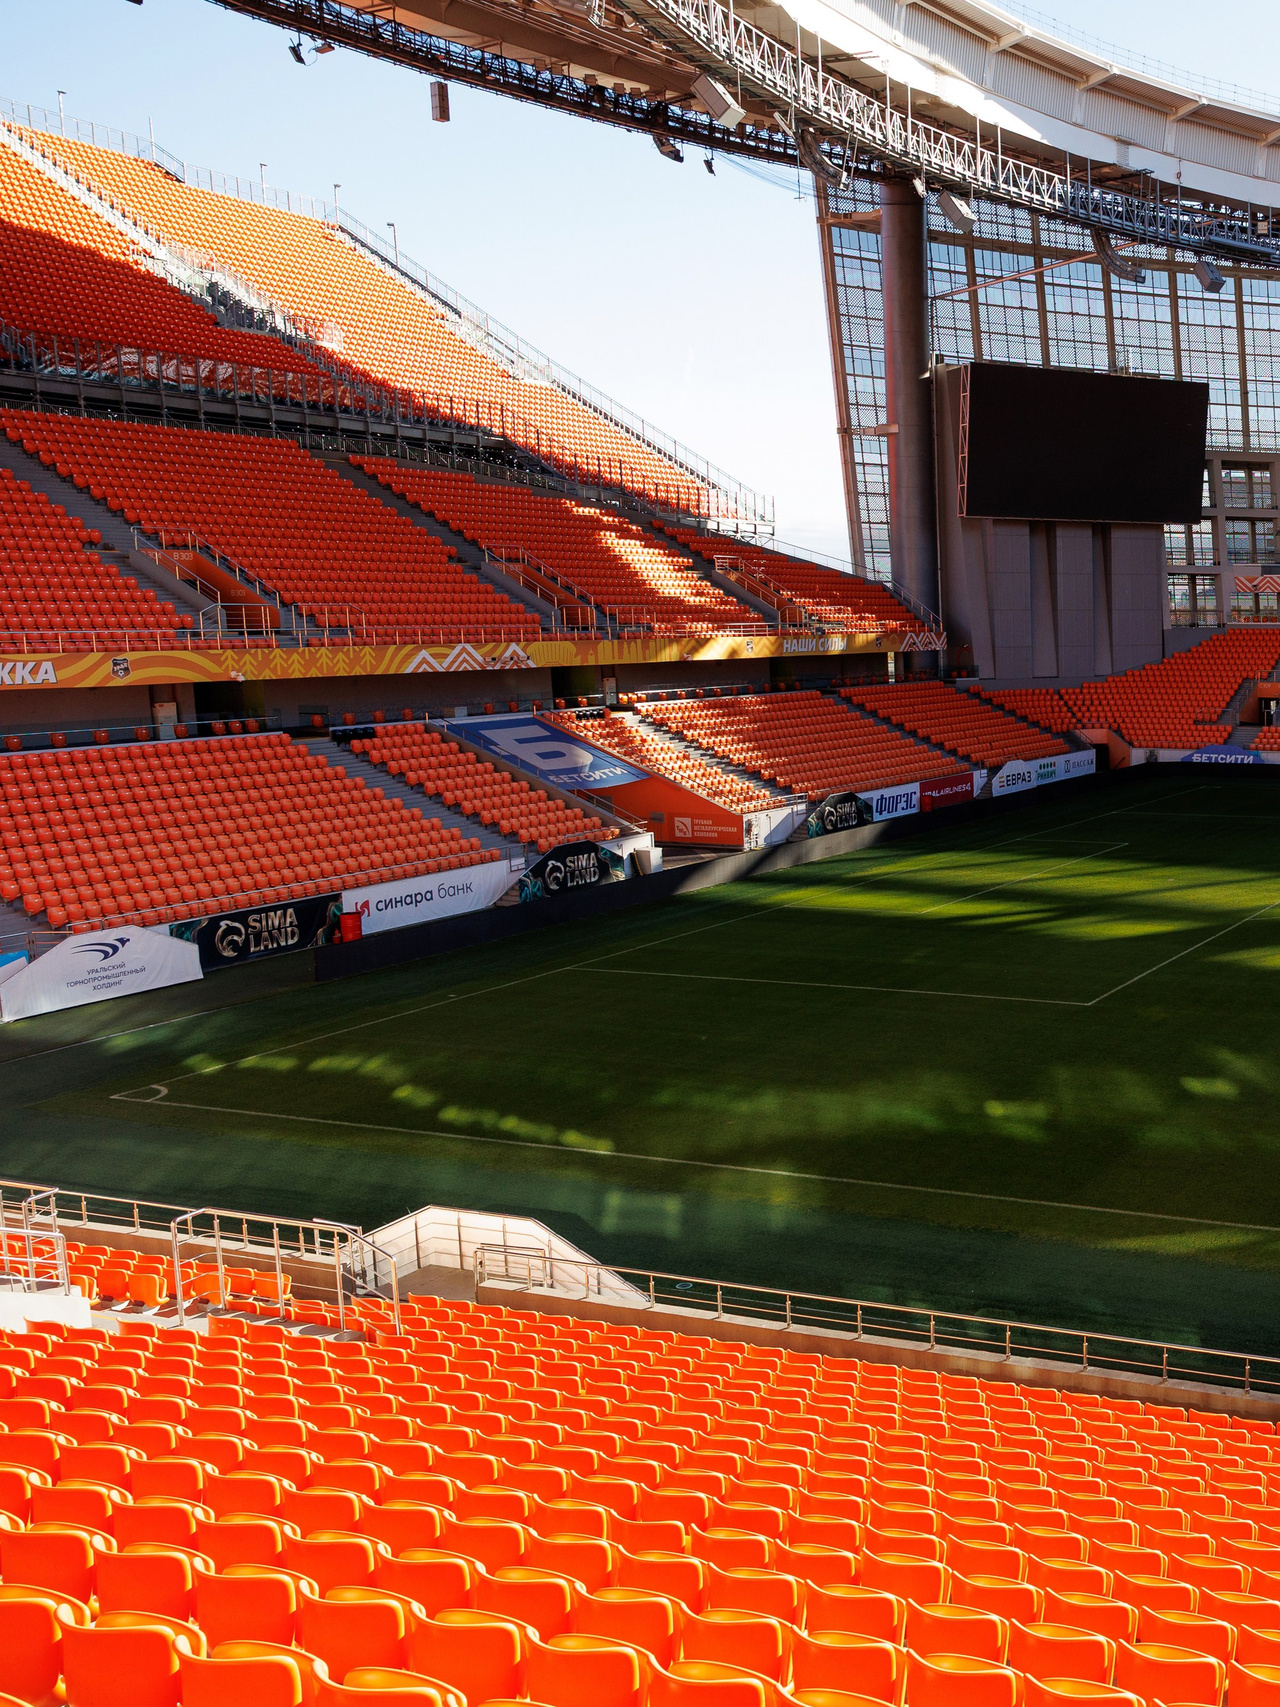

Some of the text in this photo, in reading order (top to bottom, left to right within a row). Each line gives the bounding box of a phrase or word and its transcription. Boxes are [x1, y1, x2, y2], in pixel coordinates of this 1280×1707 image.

[173, 552, 193, 560] B303
[783, 637, 847, 653] НАШИ СИЛЫ
[1191, 753, 1254, 764] БЕТСИТИ
[547, 766, 628, 783] БЕТСИТИ
[1006, 771, 1032, 787] ЕВРАЗ
[836, 801, 858, 816] SIMA
[875, 791, 917, 816] ФОРЭС
[837, 813, 858, 828] LAND
[566, 852, 599, 872] SIMA
[567, 867, 600, 888] LAND
[375, 881, 474, 913] синара банк
[247, 908, 298, 934] SIMA
[249, 927, 300, 953] LAND
[87, 961, 126, 976] УРАЛЬСКИЙ
[66, 966, 146, 988] ГОРНОПРОМЫШЛЕННЫЙ
[92, 979, 123, 991] ХОЛДИНГ
